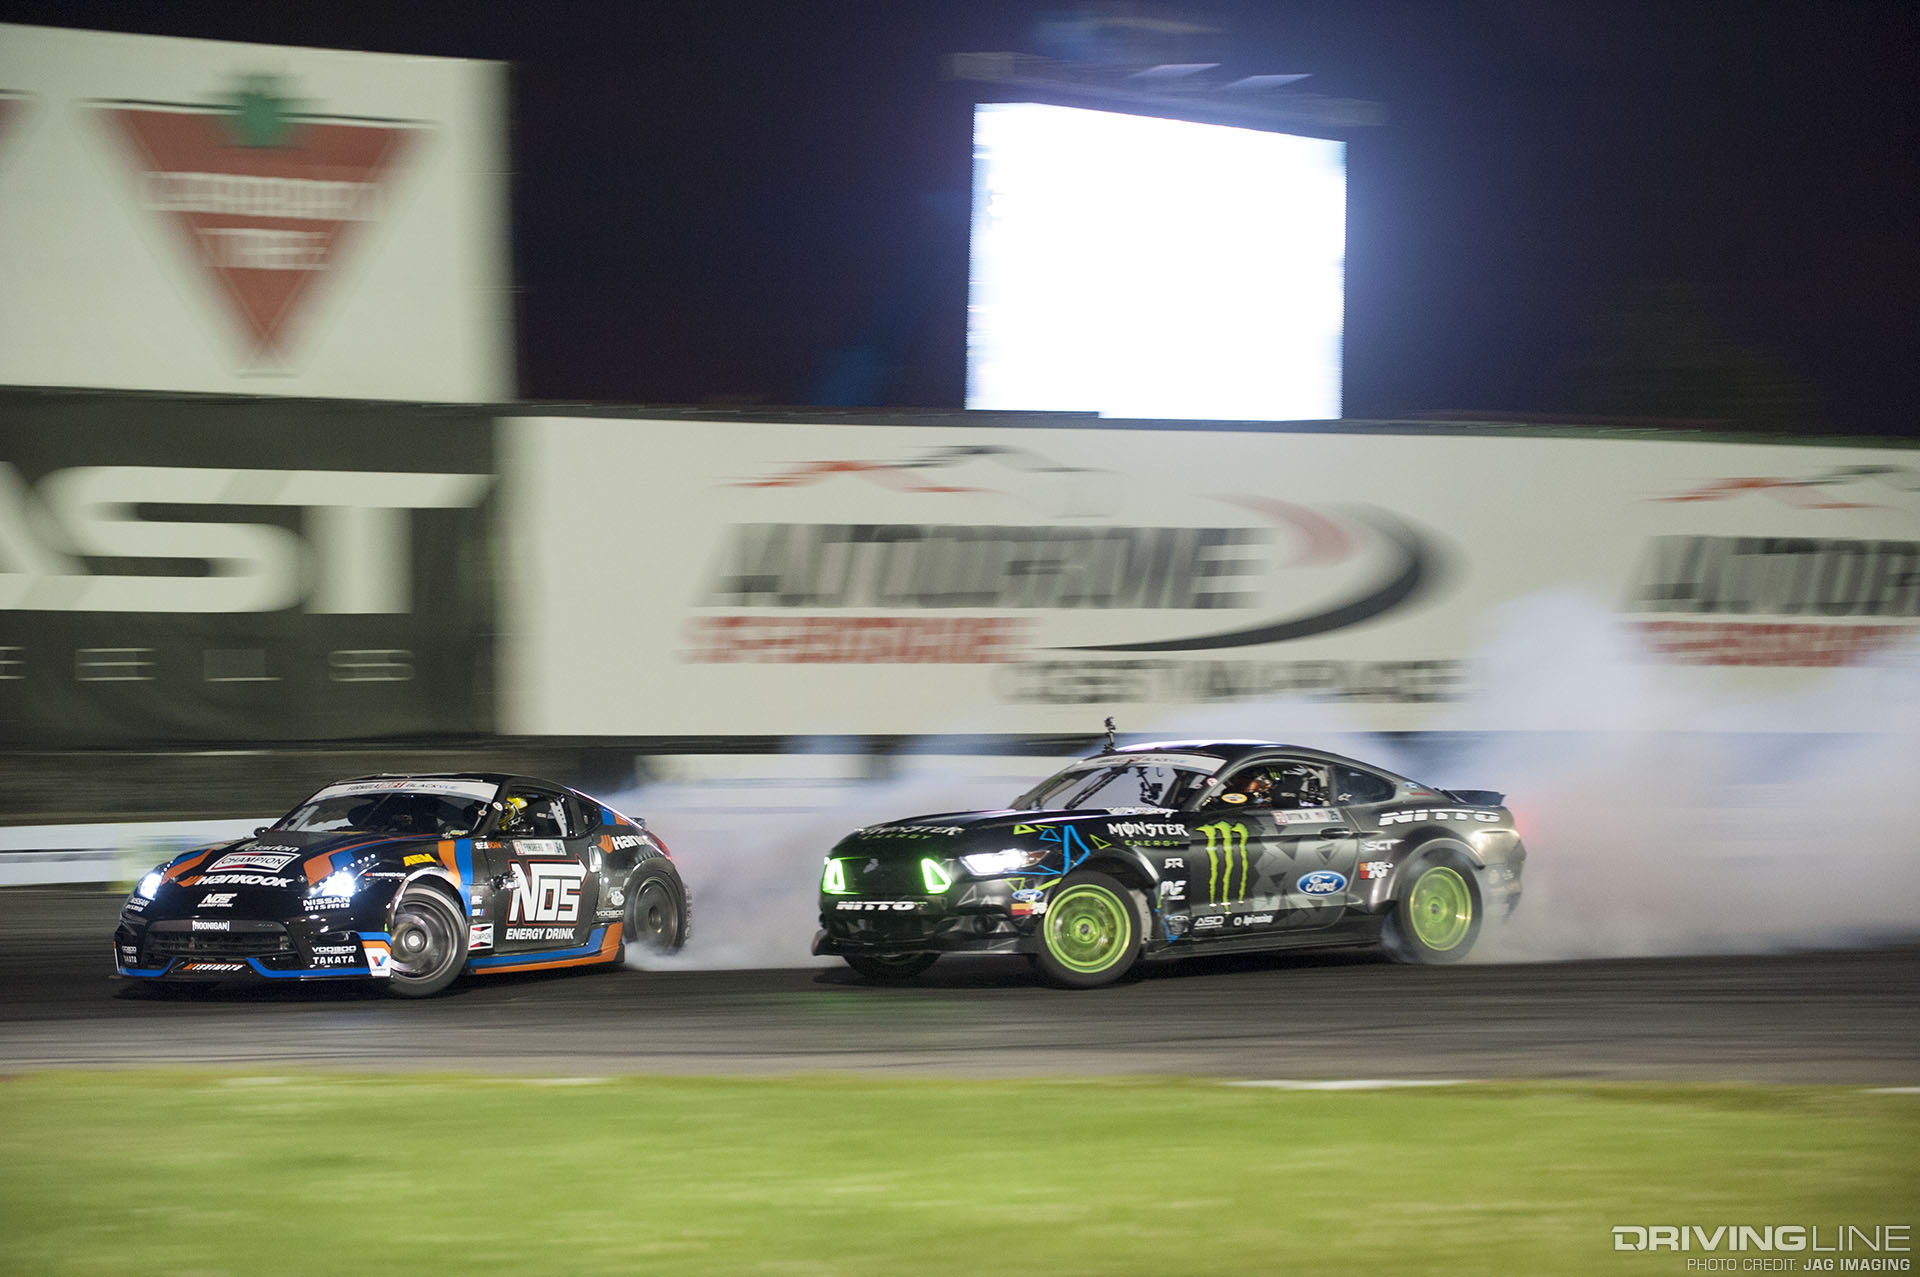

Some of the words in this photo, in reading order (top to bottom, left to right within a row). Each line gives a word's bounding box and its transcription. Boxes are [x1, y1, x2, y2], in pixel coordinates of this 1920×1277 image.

[1378, 808, 1500, 827] NITTO
[1107, 821, 1190, 837] MONSTER
[221, 856, 284, 865] CHAMPION
[506, 858, 589, 923] NOS
[201, 893, 238, 904] NOS
[303, 897, 350, 907] NISSAN
[836, 901, 915, 911] NITTO
[505, 927, 546, 941] ENERGY
[546, 927, 575, 940] DRINK
[313, 955, 355, 965] TAKATA
